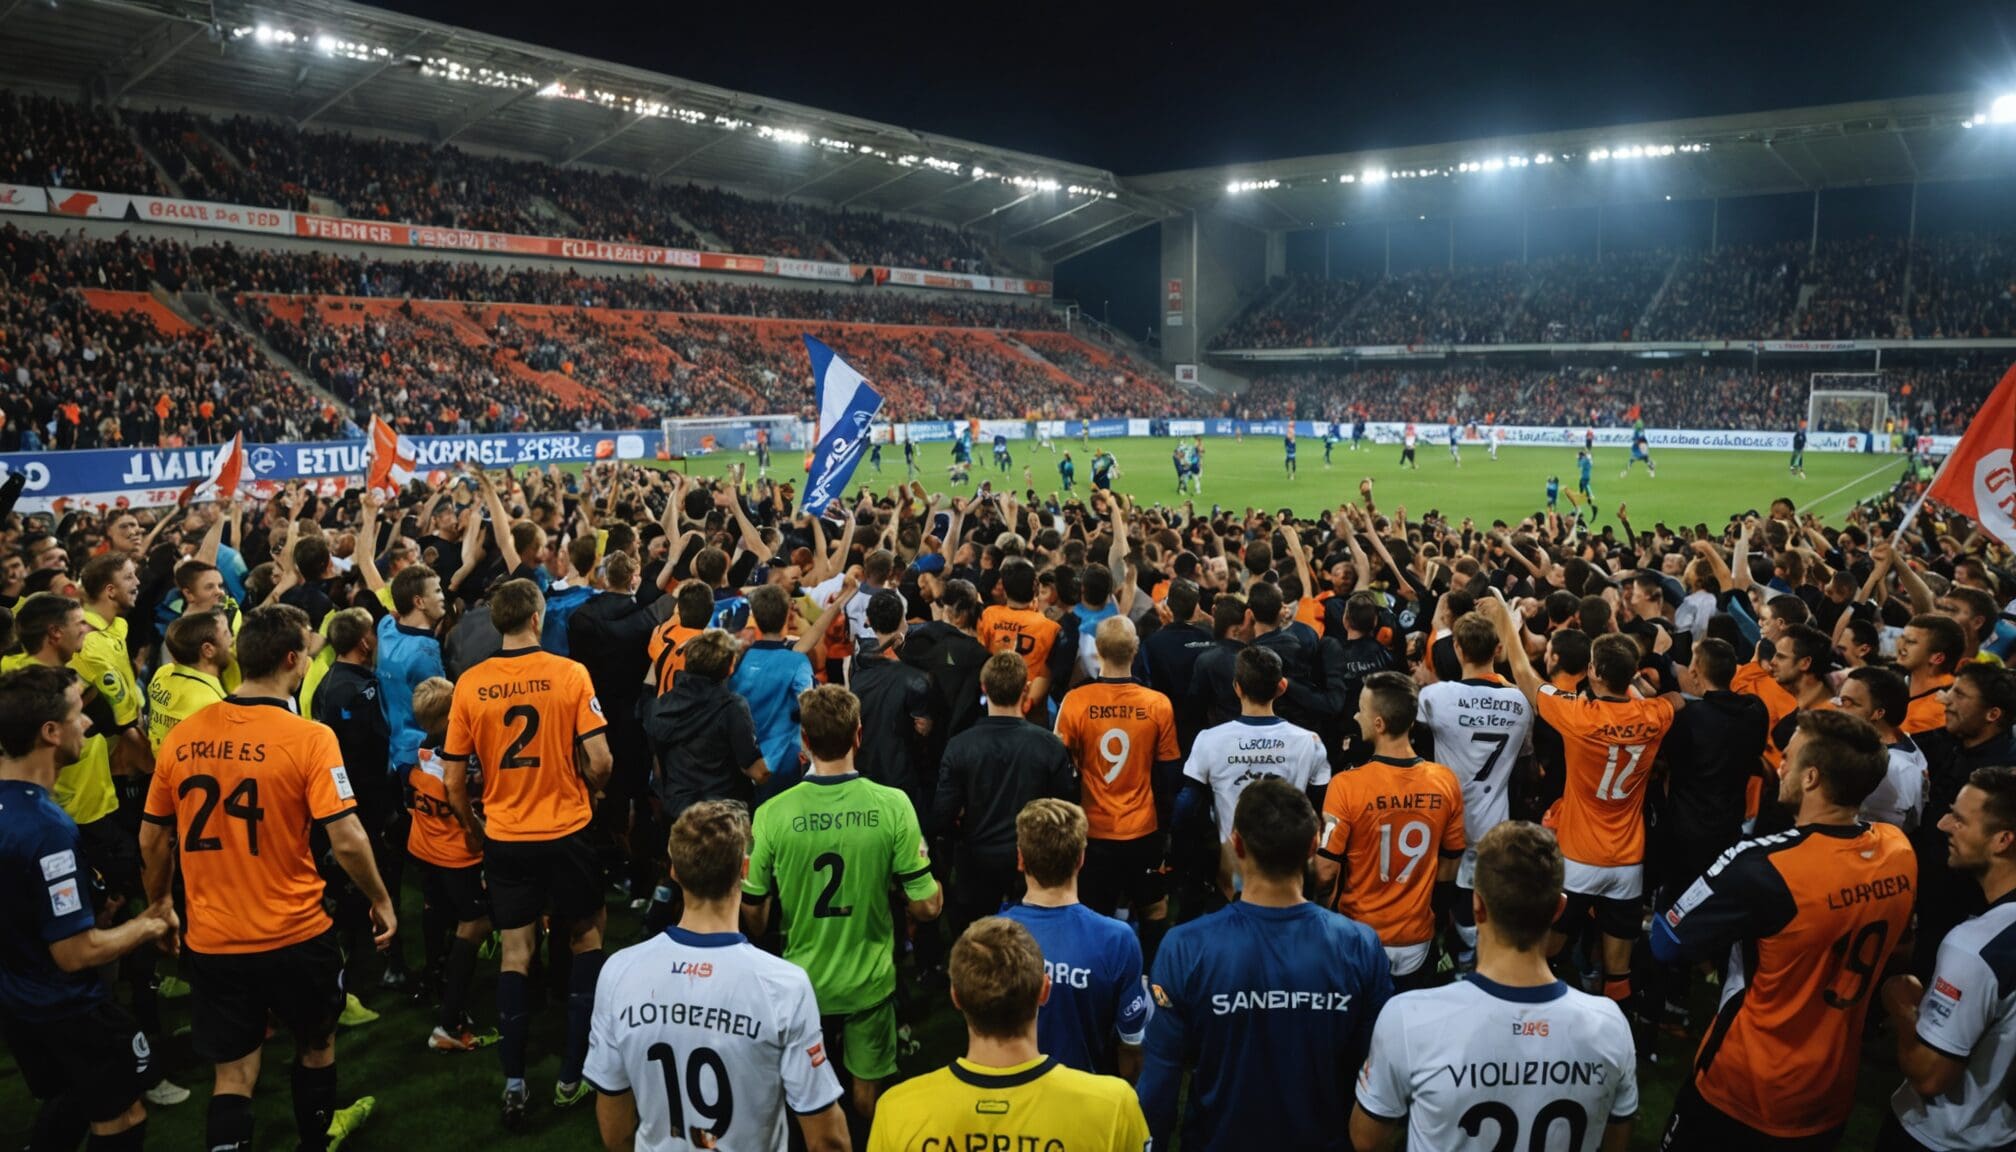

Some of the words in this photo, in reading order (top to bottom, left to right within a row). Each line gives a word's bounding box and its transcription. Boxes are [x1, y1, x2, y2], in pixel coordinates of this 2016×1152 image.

[499, 704, 542, 770] 2
[1100, 728, 1130, 784] 9
[1471, 732, 1509, 782] 7
[178, 774, 265, 857] 24
[1379, 820, 1431, 884] 19
[813, 852, 853, 919] 2
[647, 1042, 734, 1146] 19
[1458, 1098, 1588, 1152] 20
